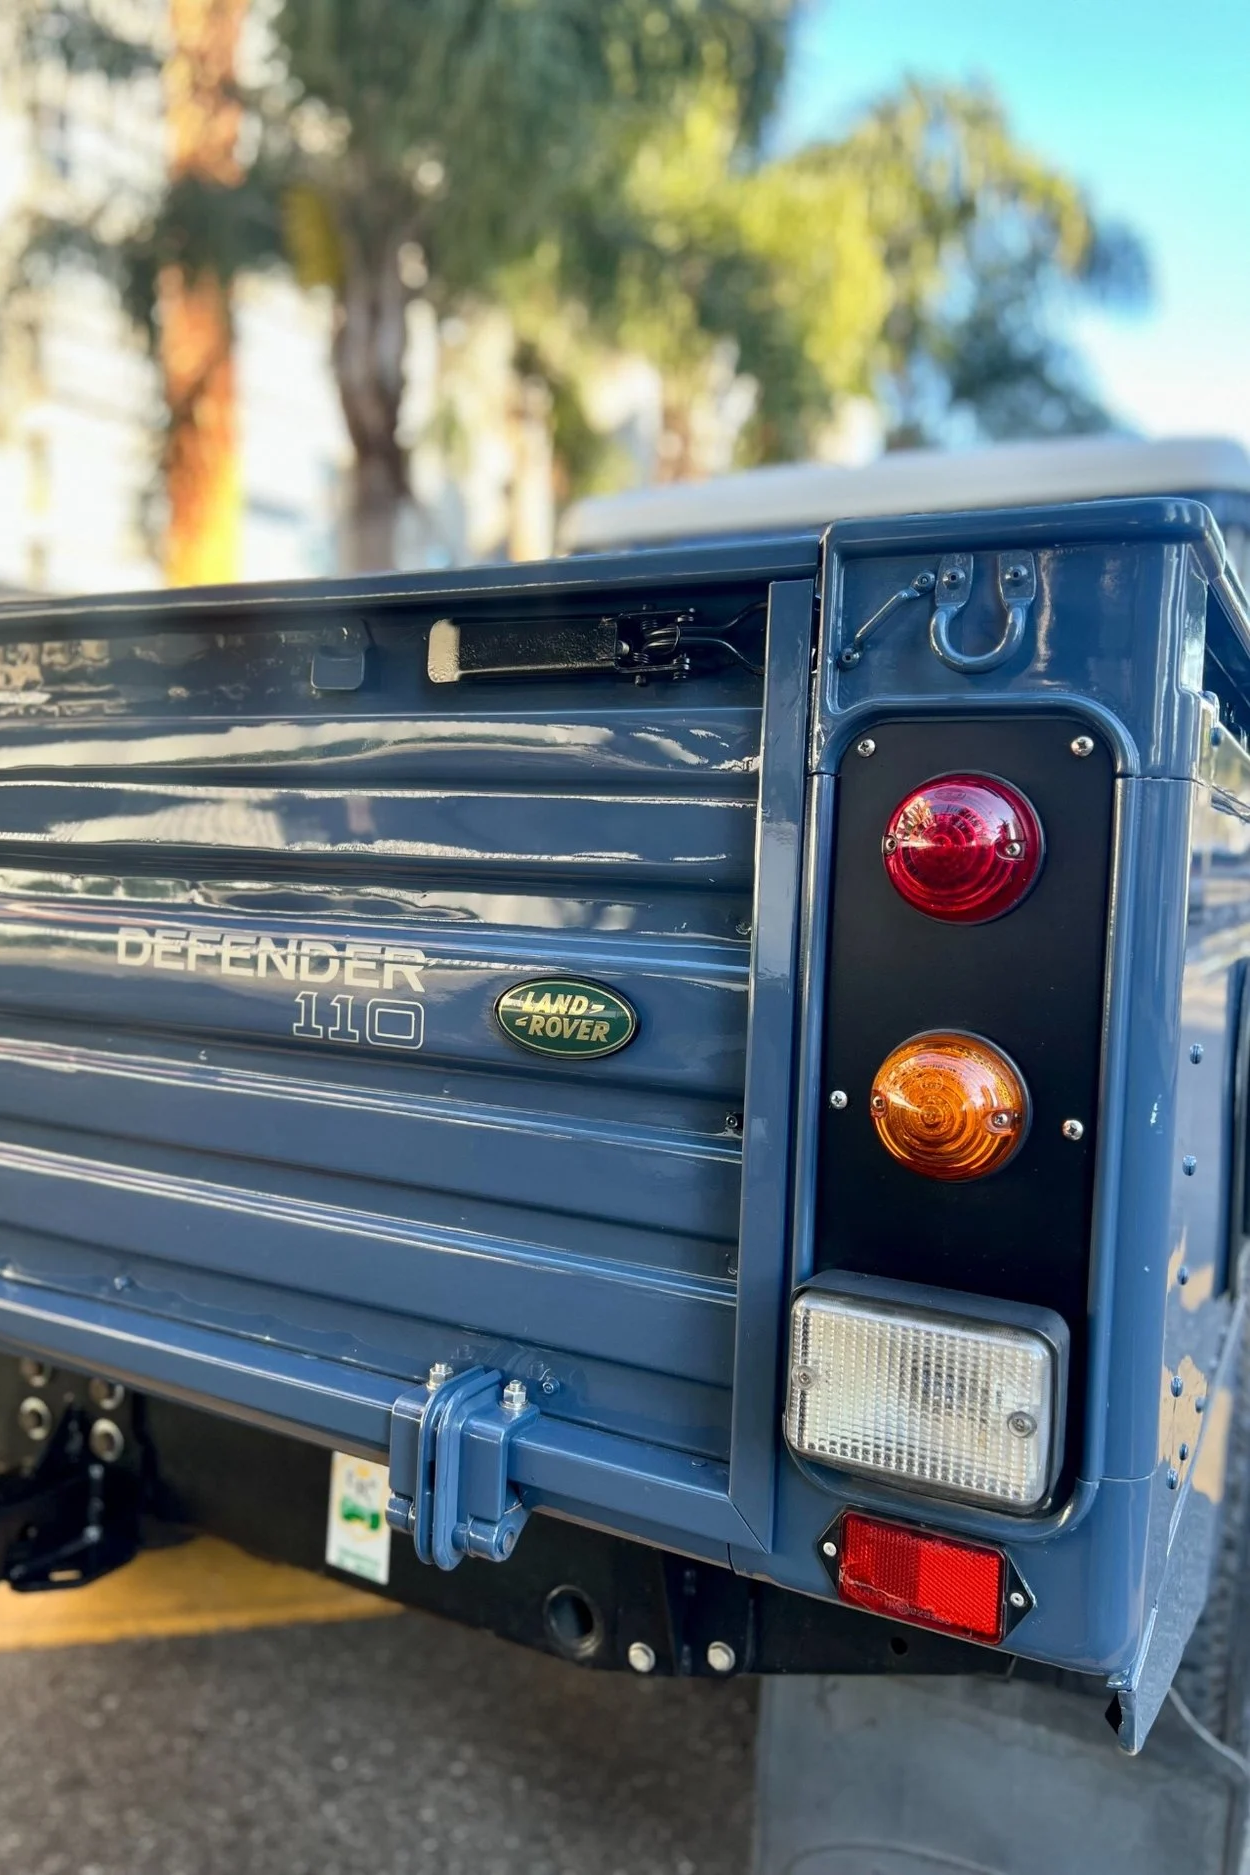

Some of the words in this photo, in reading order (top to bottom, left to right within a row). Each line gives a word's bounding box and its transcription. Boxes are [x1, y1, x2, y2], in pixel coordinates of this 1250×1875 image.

[116, 927, 427, 993] DEFENDER
[292, 991, 425, 1050] 110
[521, 991, 589, 1016] LAND
[527, 1014, 608, 1043] ROVER
